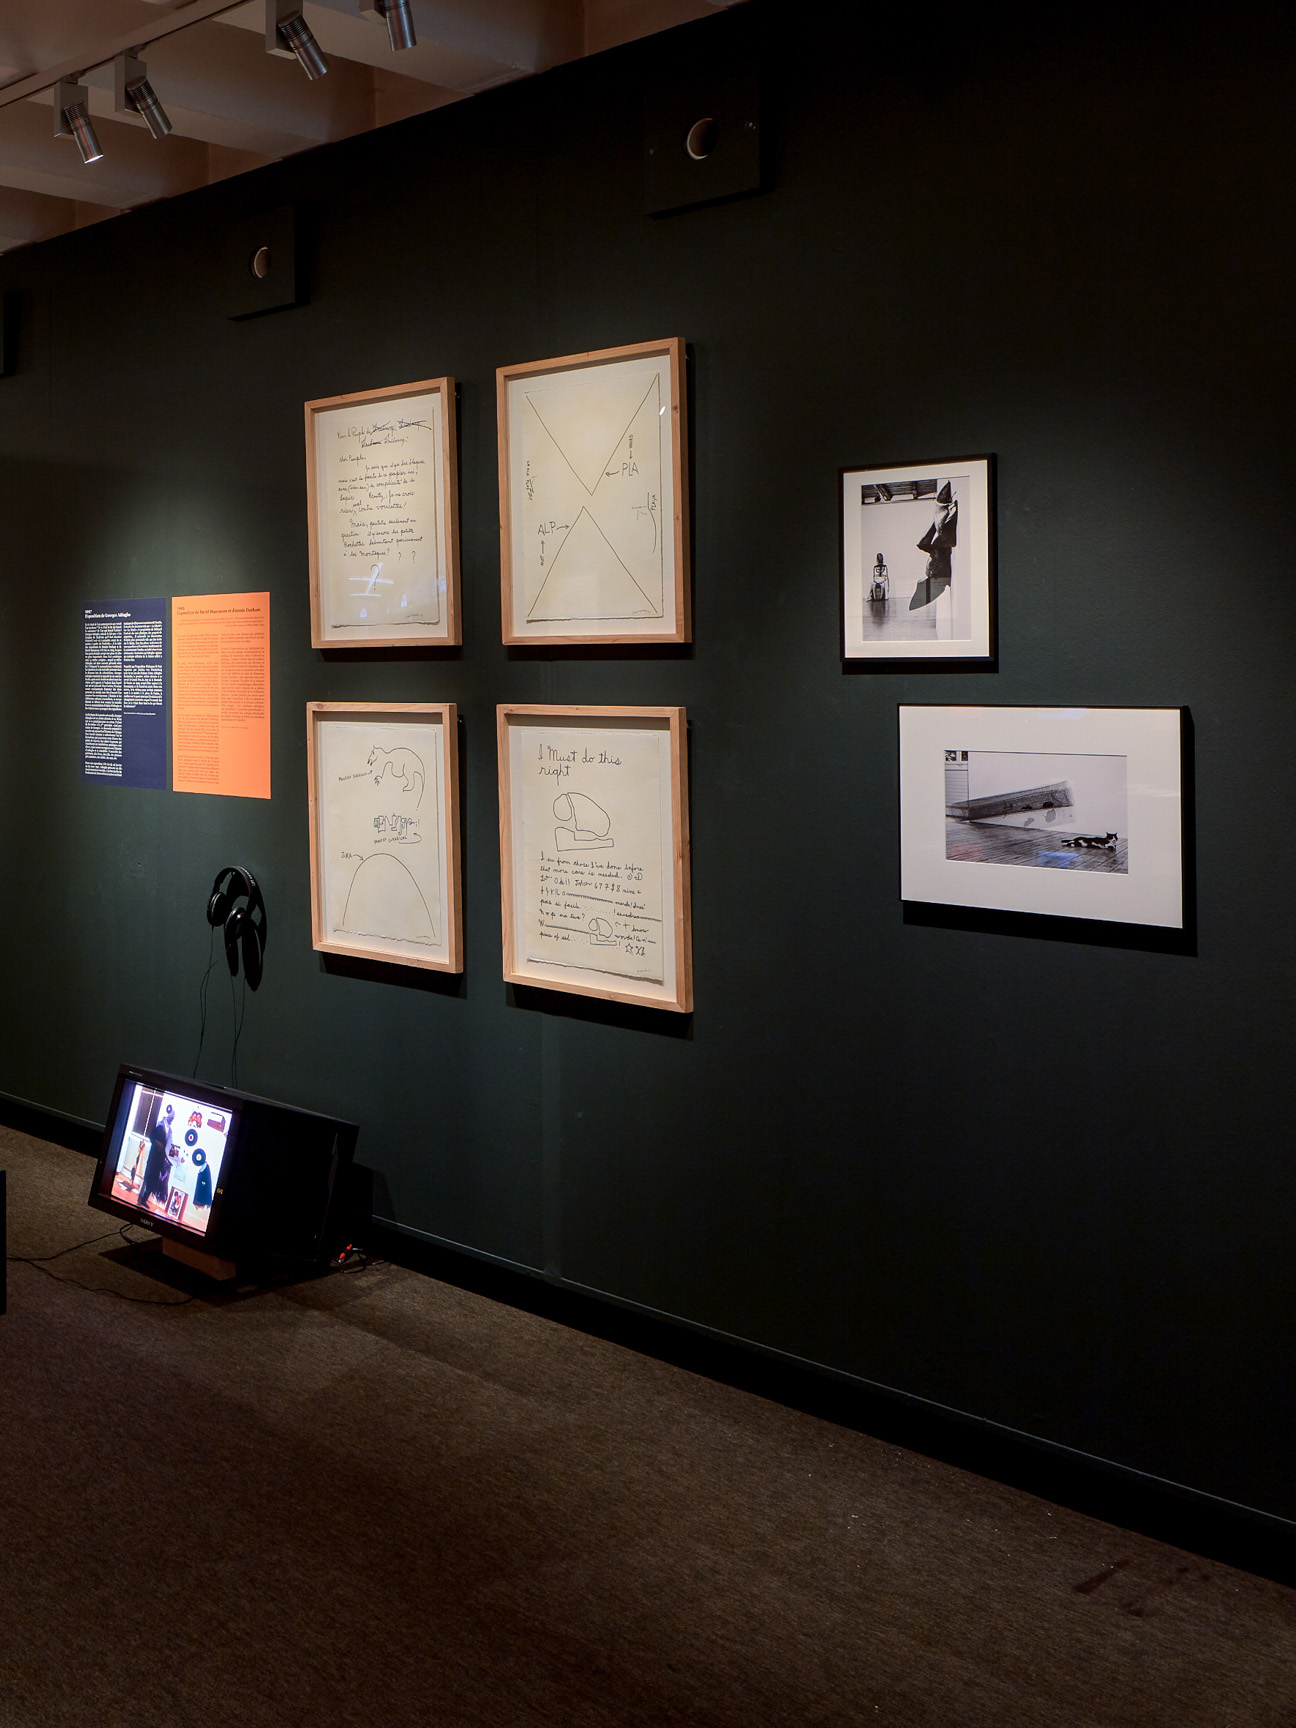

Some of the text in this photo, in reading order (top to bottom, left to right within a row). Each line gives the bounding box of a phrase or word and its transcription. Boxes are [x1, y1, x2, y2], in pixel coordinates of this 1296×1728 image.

[622, 461, 639, 477] PLA
[537, 521, 556, 536] ALP
[547, 745, 578, 762] Must
[582, 747, 595, 763] do
[598, 750, 623, 765] this
[538, 763, 571, 786] right
